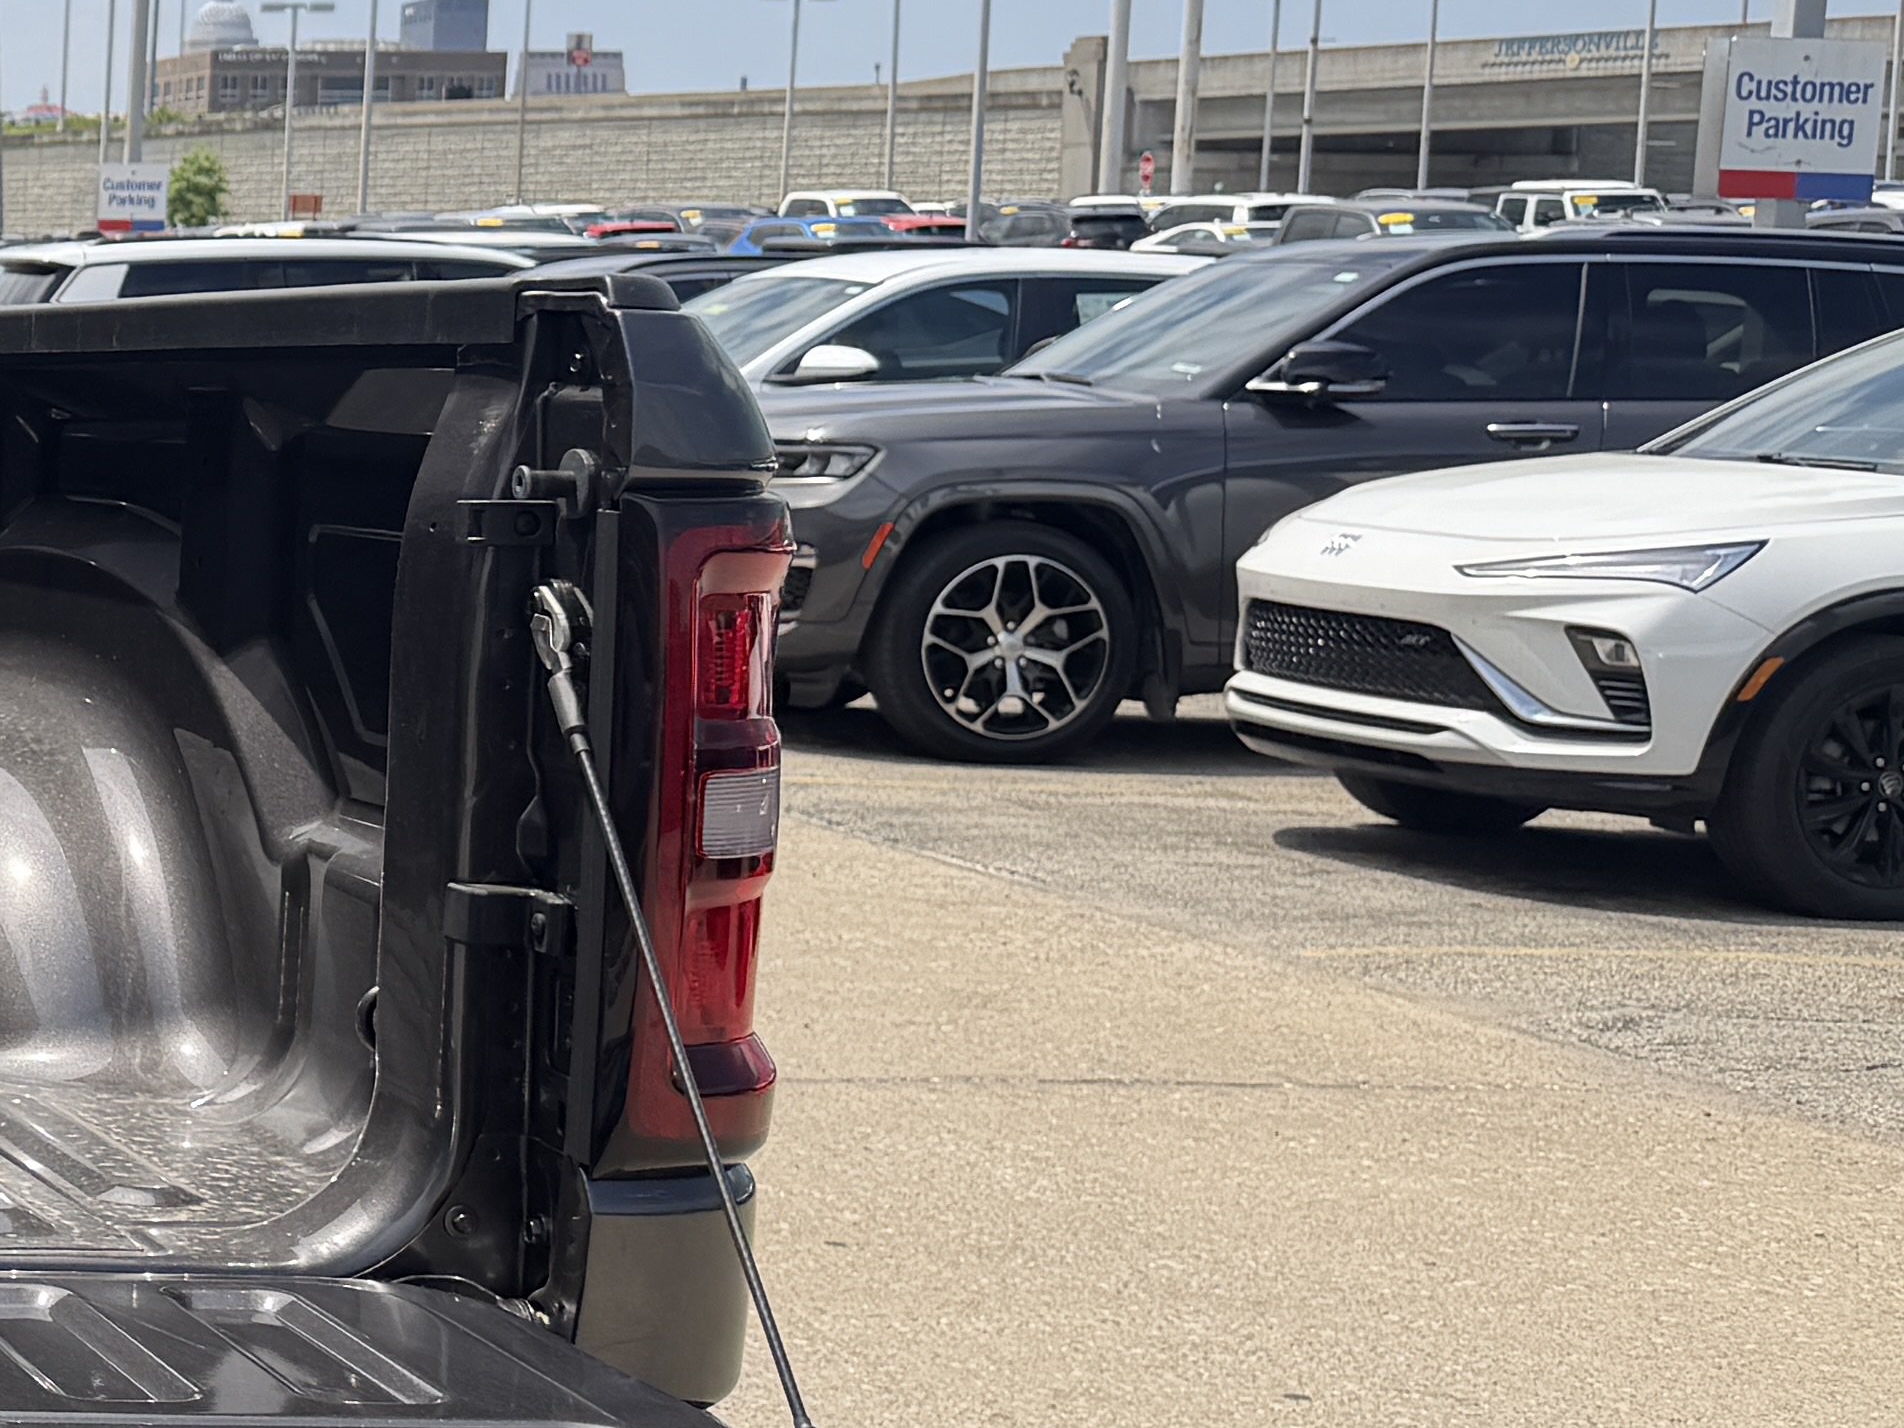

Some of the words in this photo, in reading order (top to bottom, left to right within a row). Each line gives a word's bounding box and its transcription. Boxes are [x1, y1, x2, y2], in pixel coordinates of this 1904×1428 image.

[1735, 71, 1875, 105] Customer
[1746, 109, 1855, 148] Parking
[103, 177, 162, 192] Customer
[108, 193, 156, 210] Parking
